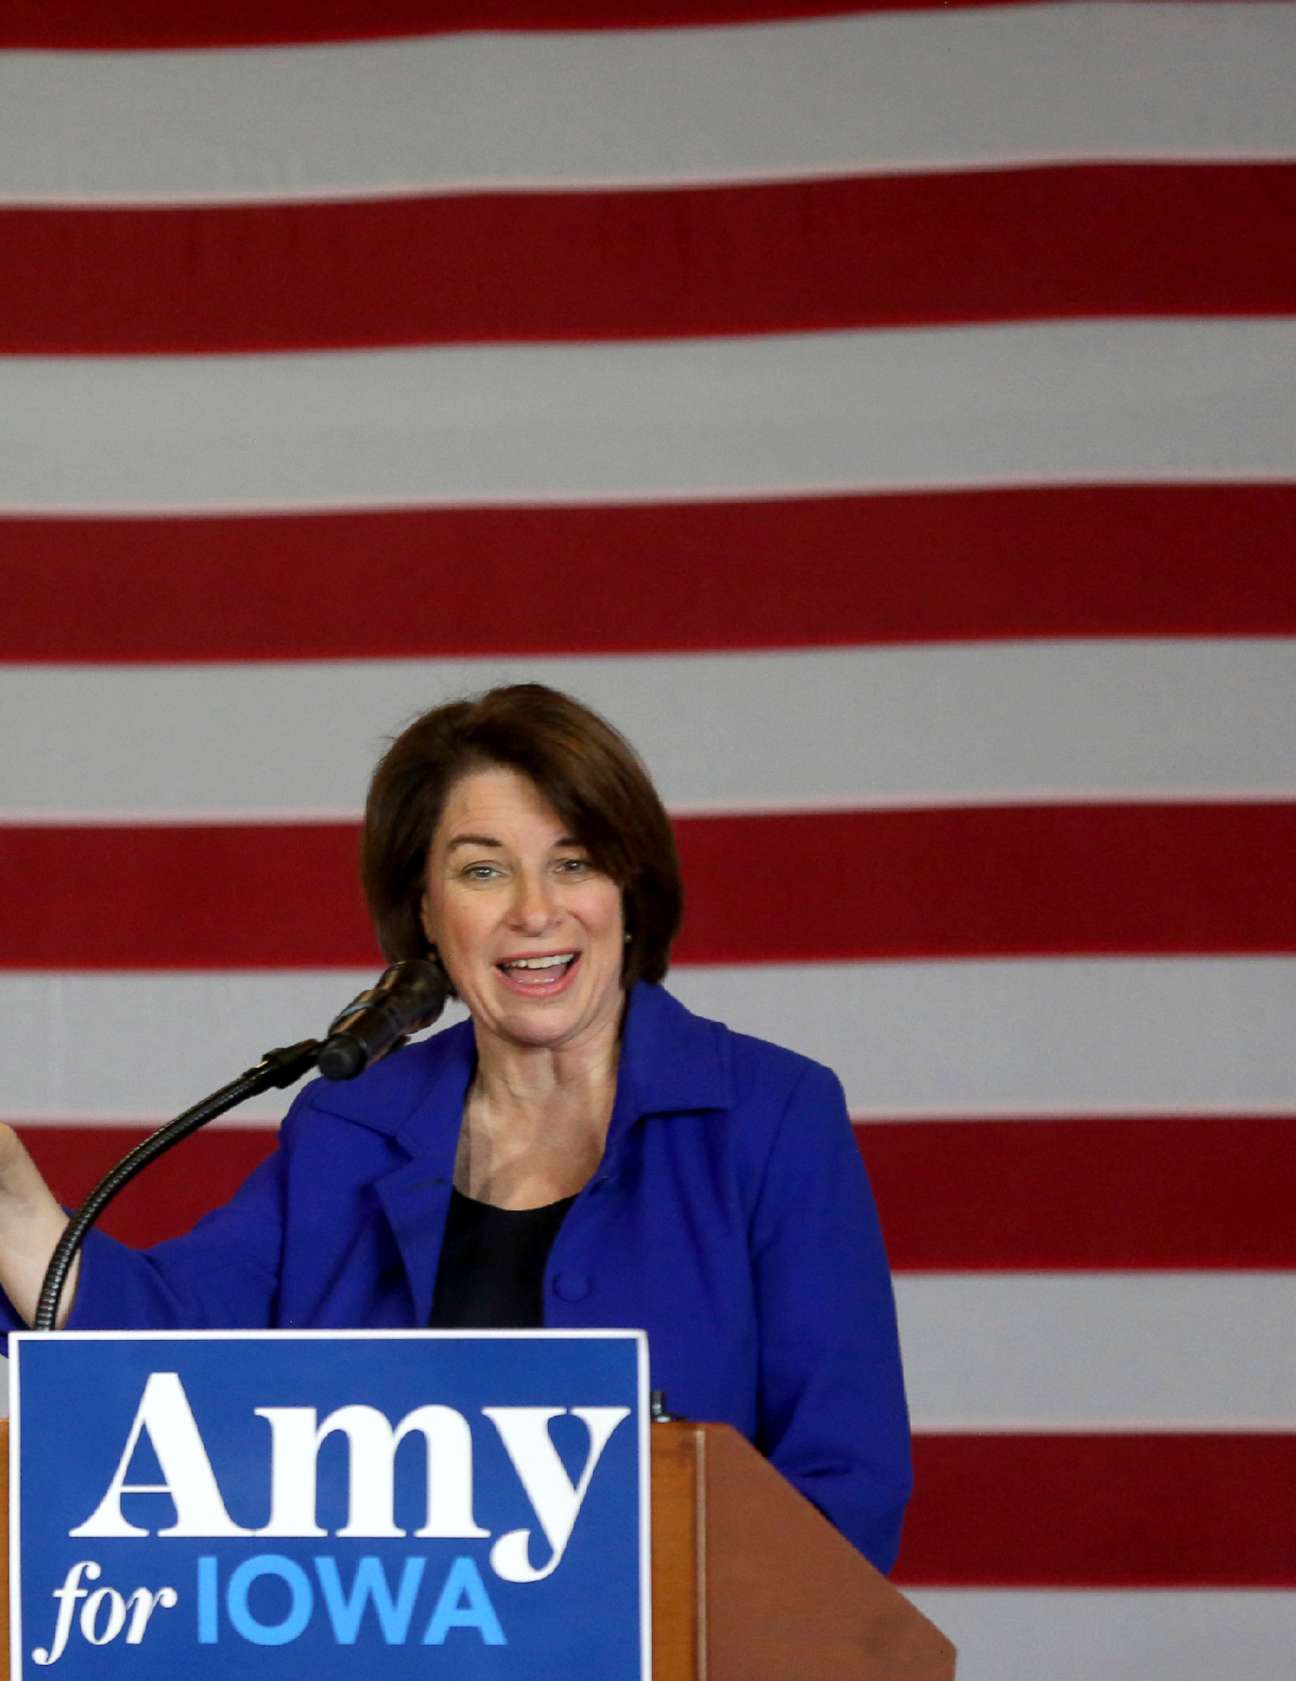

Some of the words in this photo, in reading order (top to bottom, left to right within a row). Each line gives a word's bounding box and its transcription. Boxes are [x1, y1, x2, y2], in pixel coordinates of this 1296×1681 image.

[69, 1372, 631, 1583] Amy
[32, 1560, 177, 1665] for
[197, 1554, 507, 1646] IOWA
